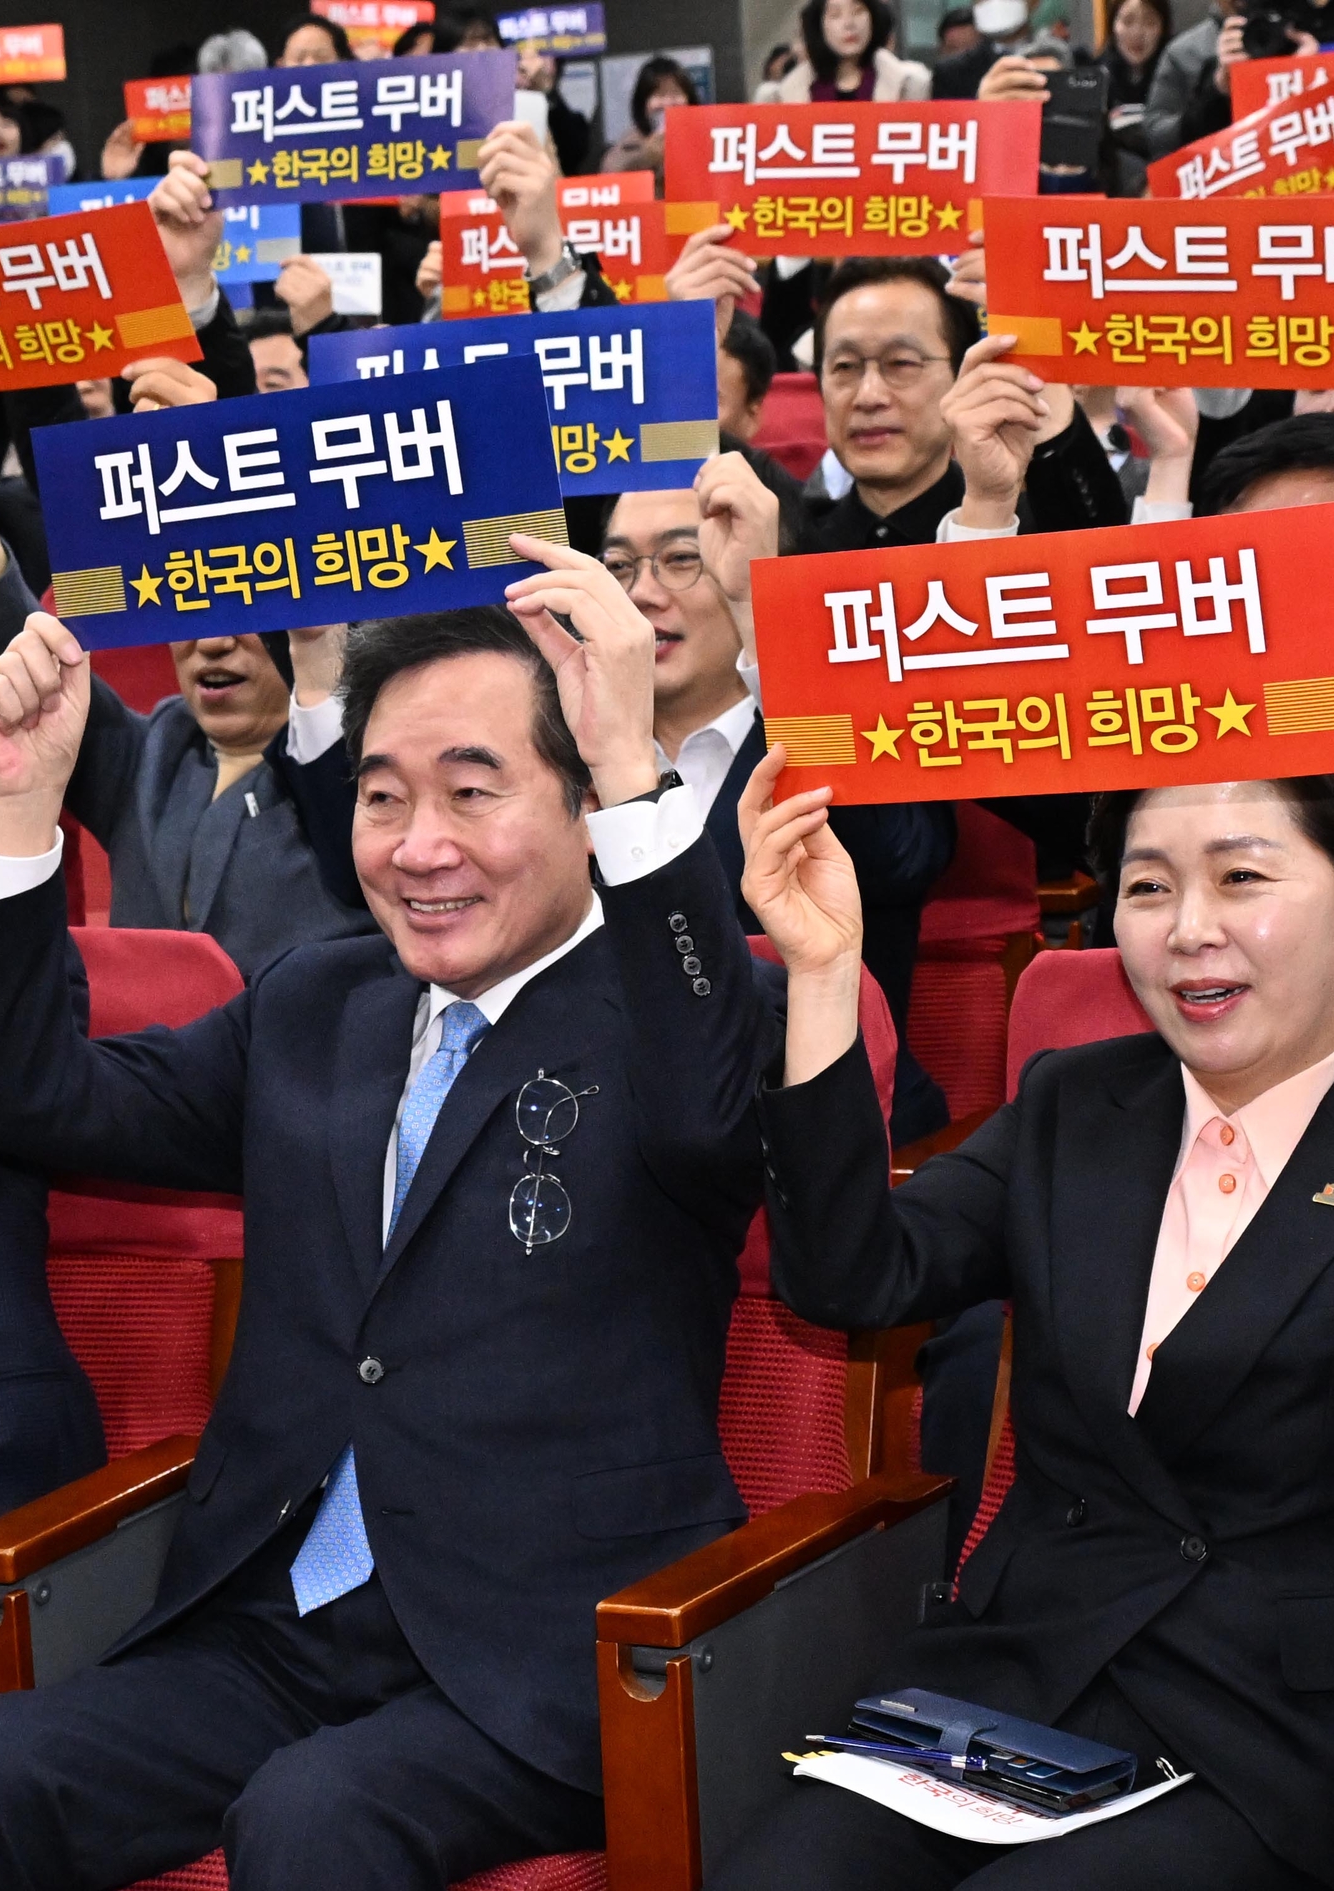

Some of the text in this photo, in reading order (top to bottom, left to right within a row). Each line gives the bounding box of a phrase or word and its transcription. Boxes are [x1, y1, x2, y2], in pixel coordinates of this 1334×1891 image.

[230, 69, 464, 143] 퍼스트 무버
[271, 139, 426, 190] 한국의 희망
[708, 120, 978, 186] 퍼스트 무버
[1176, 130, 1266, 199] 퍼스트
[460, 225, 528, 274] 퍼스
[753, 196, 932, 238] 한국의 희망
[1042, 223, 1238, 300] 퍼스트
[488, 279, 529, 311] 한국
[15, 318, 85, 366] 희망
[534, 328, 645, 411] 무버
[1105, 314, 1334, 368] 한국의 희망
[94, 399, 465, 535] 퍼스트 무버
[553, 423, 602, 473] 망
[164, 524, 413, 612] 한국의 희망
[823, 548, 1267, 683] 퍼스트 무버
[906, 683, 1202, 768] 한국의 희망
[898, 1773, 976, 1808] 한국의
